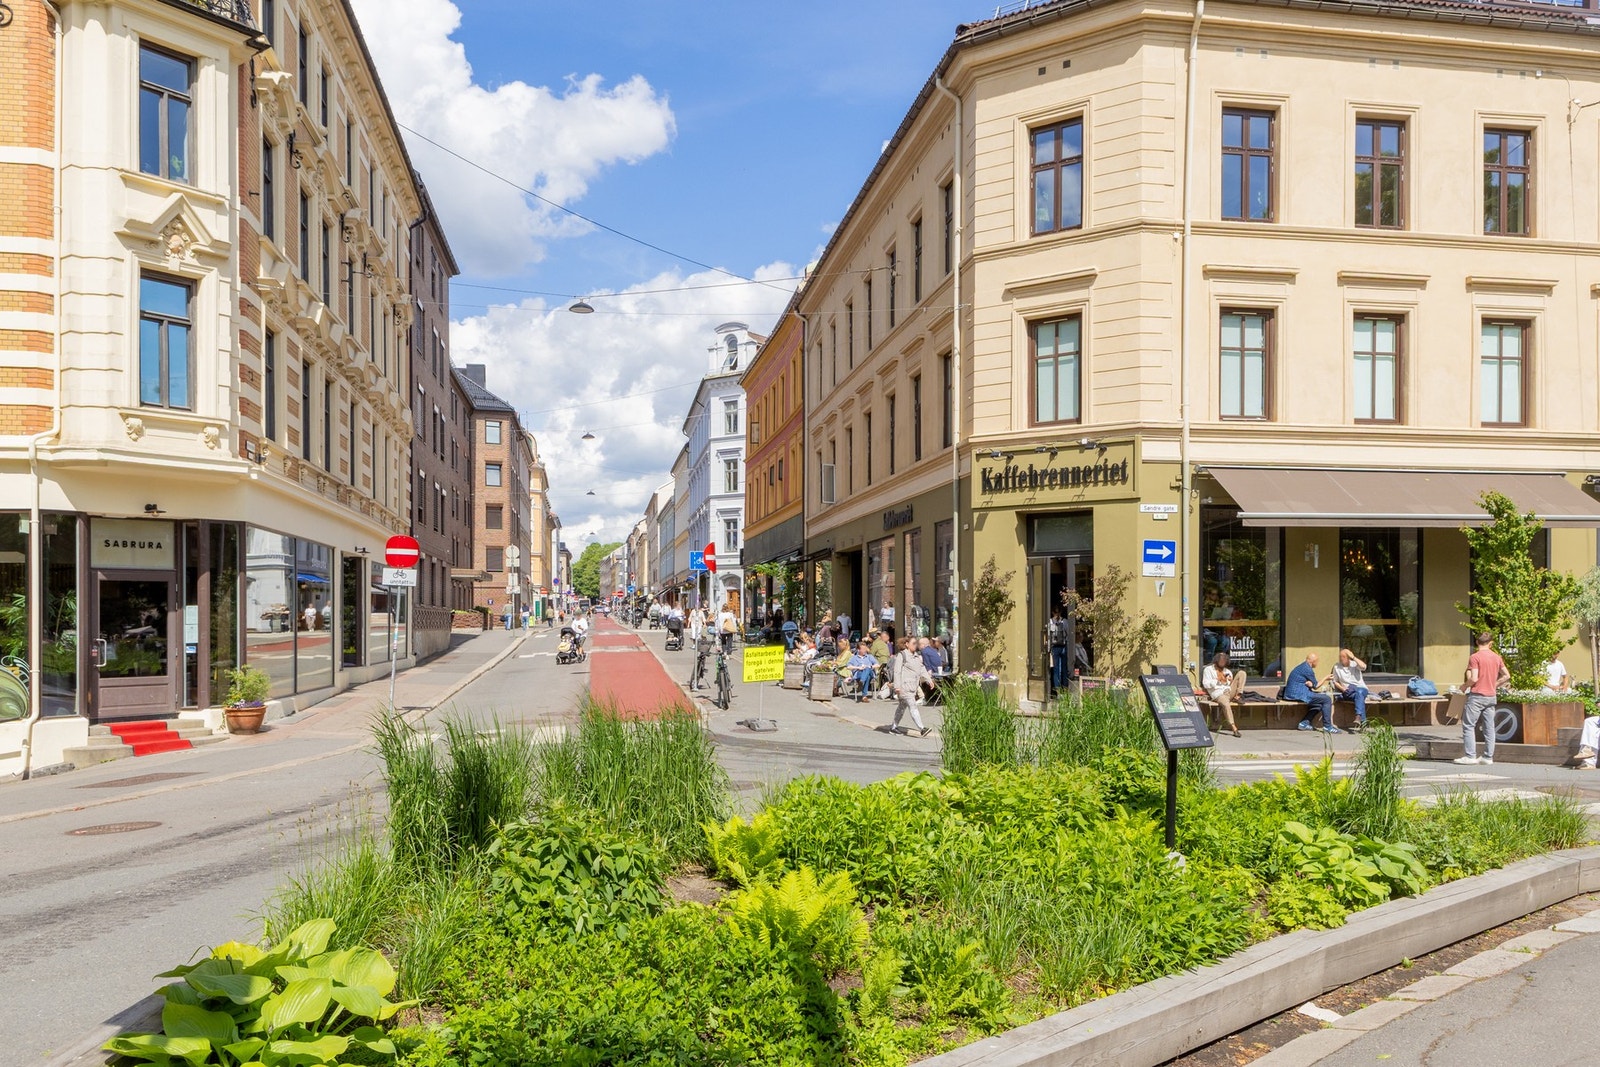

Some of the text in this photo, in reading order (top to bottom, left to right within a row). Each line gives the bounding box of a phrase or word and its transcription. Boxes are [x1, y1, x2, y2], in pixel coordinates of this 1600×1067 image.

[981, 457, 1129, 493] Kaffebrenneriet
[104, 539, 163, 549] SABRURA
[1229, 636, 1255, 650] Kaffe
[745, 650, 777, 658] Asfaltarbeid
[1229, 649, 1256, 657] brenneriet
[754, 666, 775, 675] gate/vei
